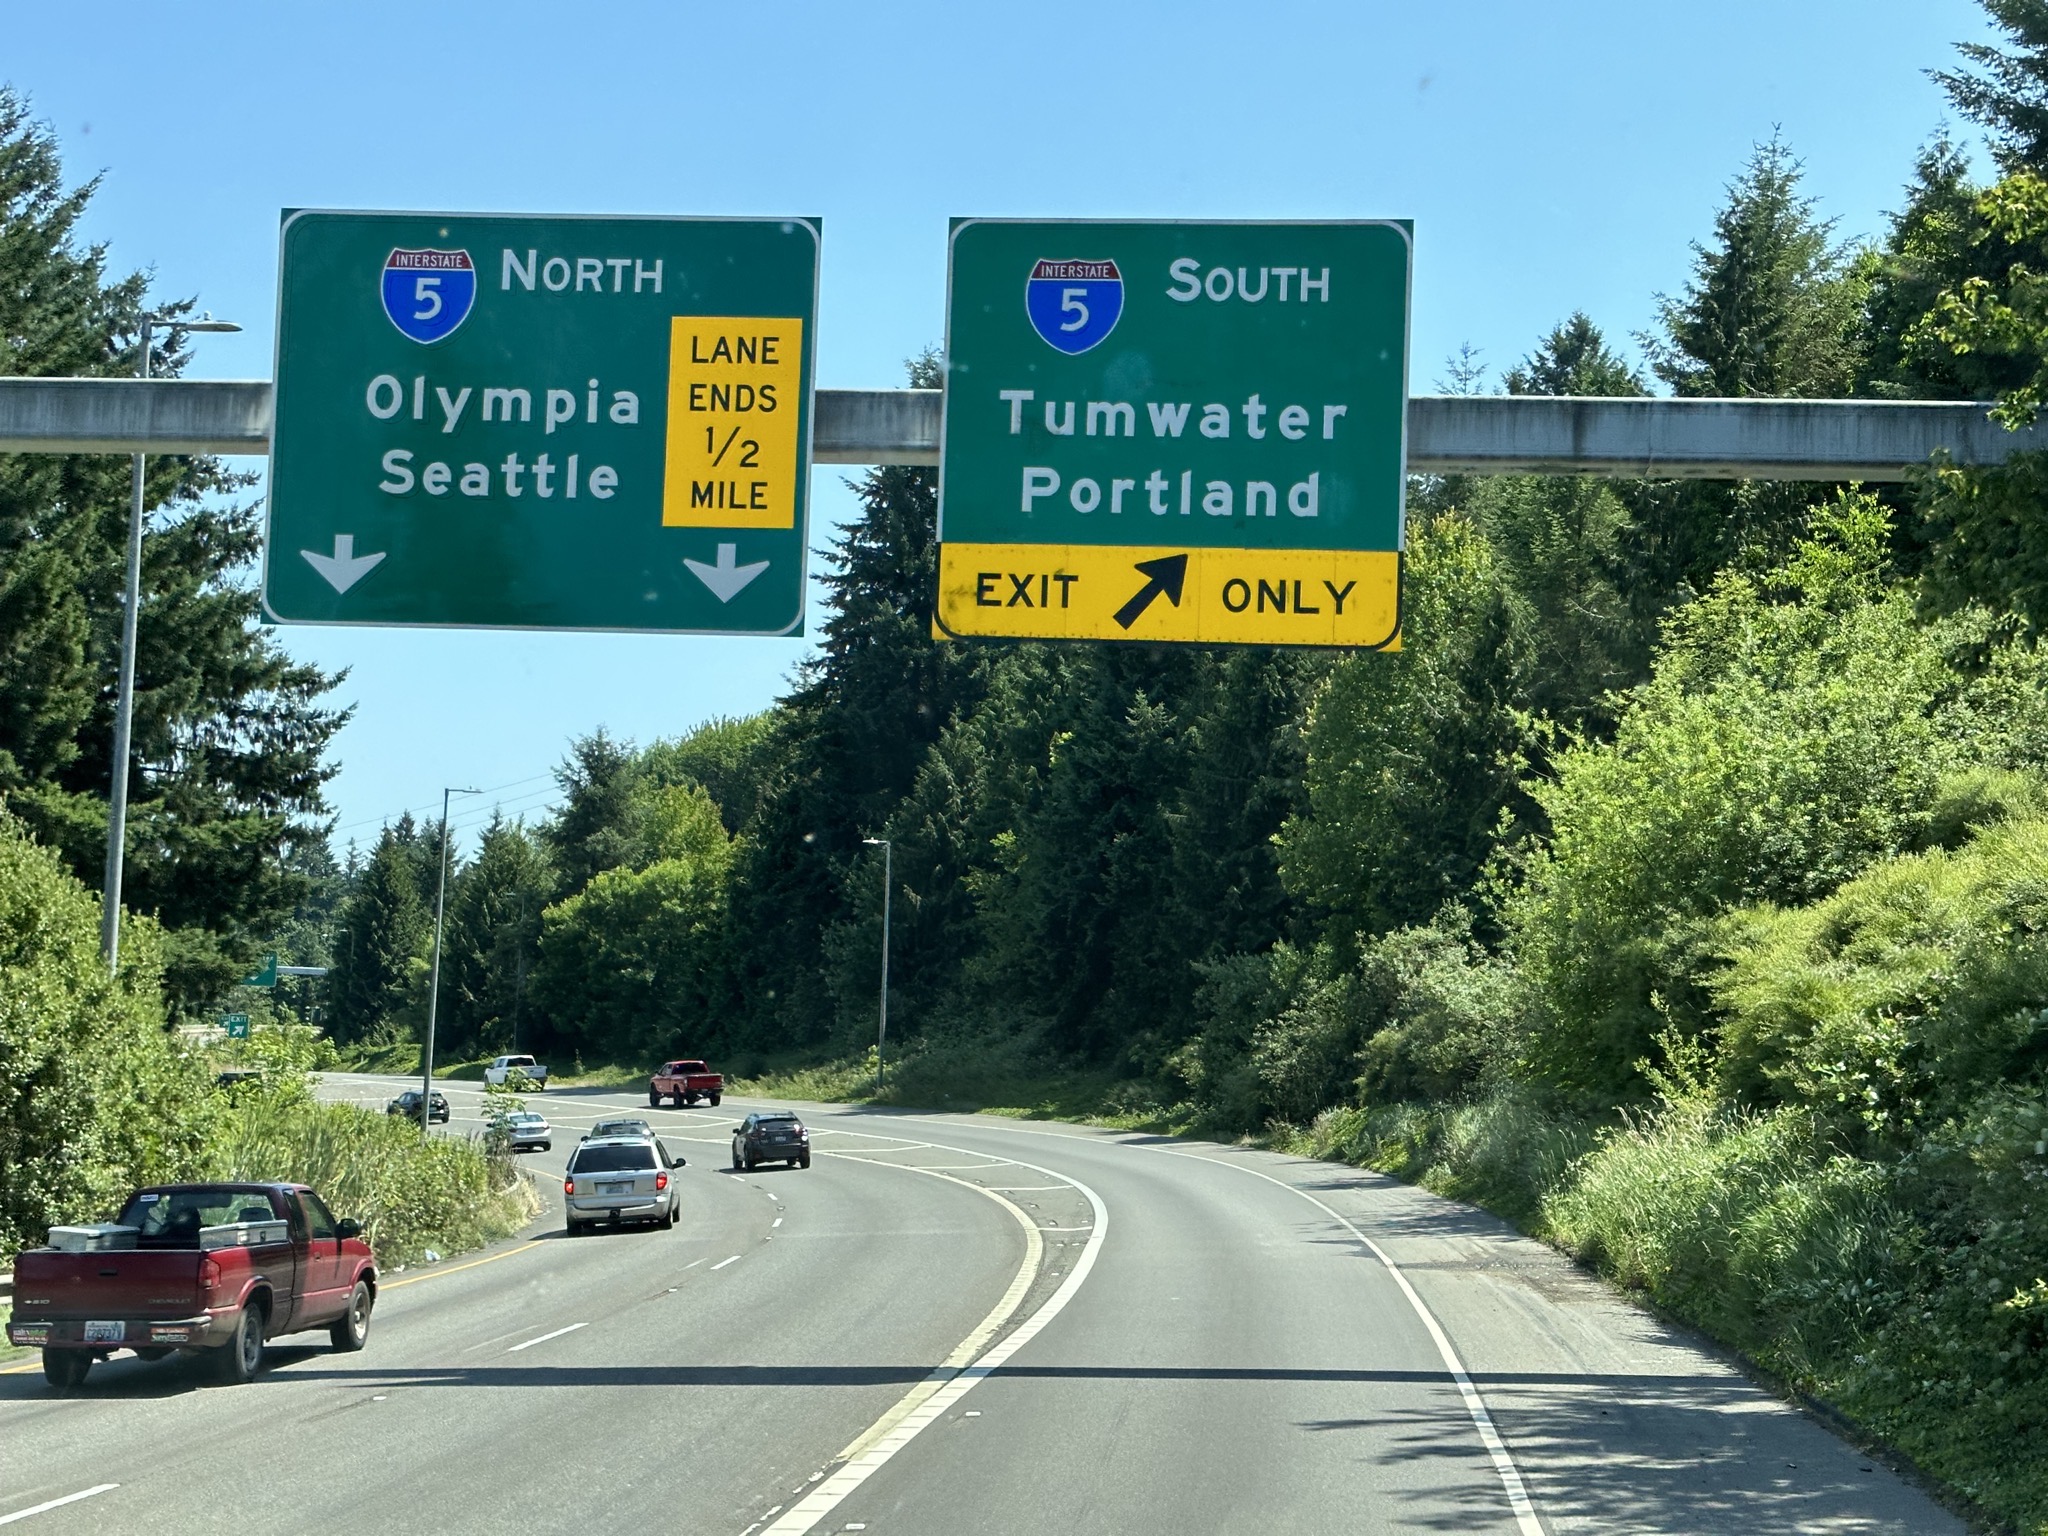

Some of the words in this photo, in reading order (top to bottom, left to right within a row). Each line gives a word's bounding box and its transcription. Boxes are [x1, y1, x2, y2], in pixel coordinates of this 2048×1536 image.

[395, 252, 464, 268] INTERSTATE
[501, 249, 663, 293] NORTH
[1041, 263, 1110, 278] INTERSTATE
[1166, 258, 1330, 302] SOUTH
[413, 277, 442, 320] 5
[1060, 289, 1089, 331] 5
[691, 335, 780, 365] LANE
[366, 374, 639, 434] Olympia
[689, 383, 778, 412] ENDS
[1000, 390, 1347, 440] Tumwater
[706, 426, 760, 468] 1/2
[379, 449, 619, 499] Seattle
[691, 480, 768, 510] MILE
[1021, 466, 1319, 517] Portland
[976, 572, 1079, 608] EXIT
[1222, 578, 1357, 615] ONLY
